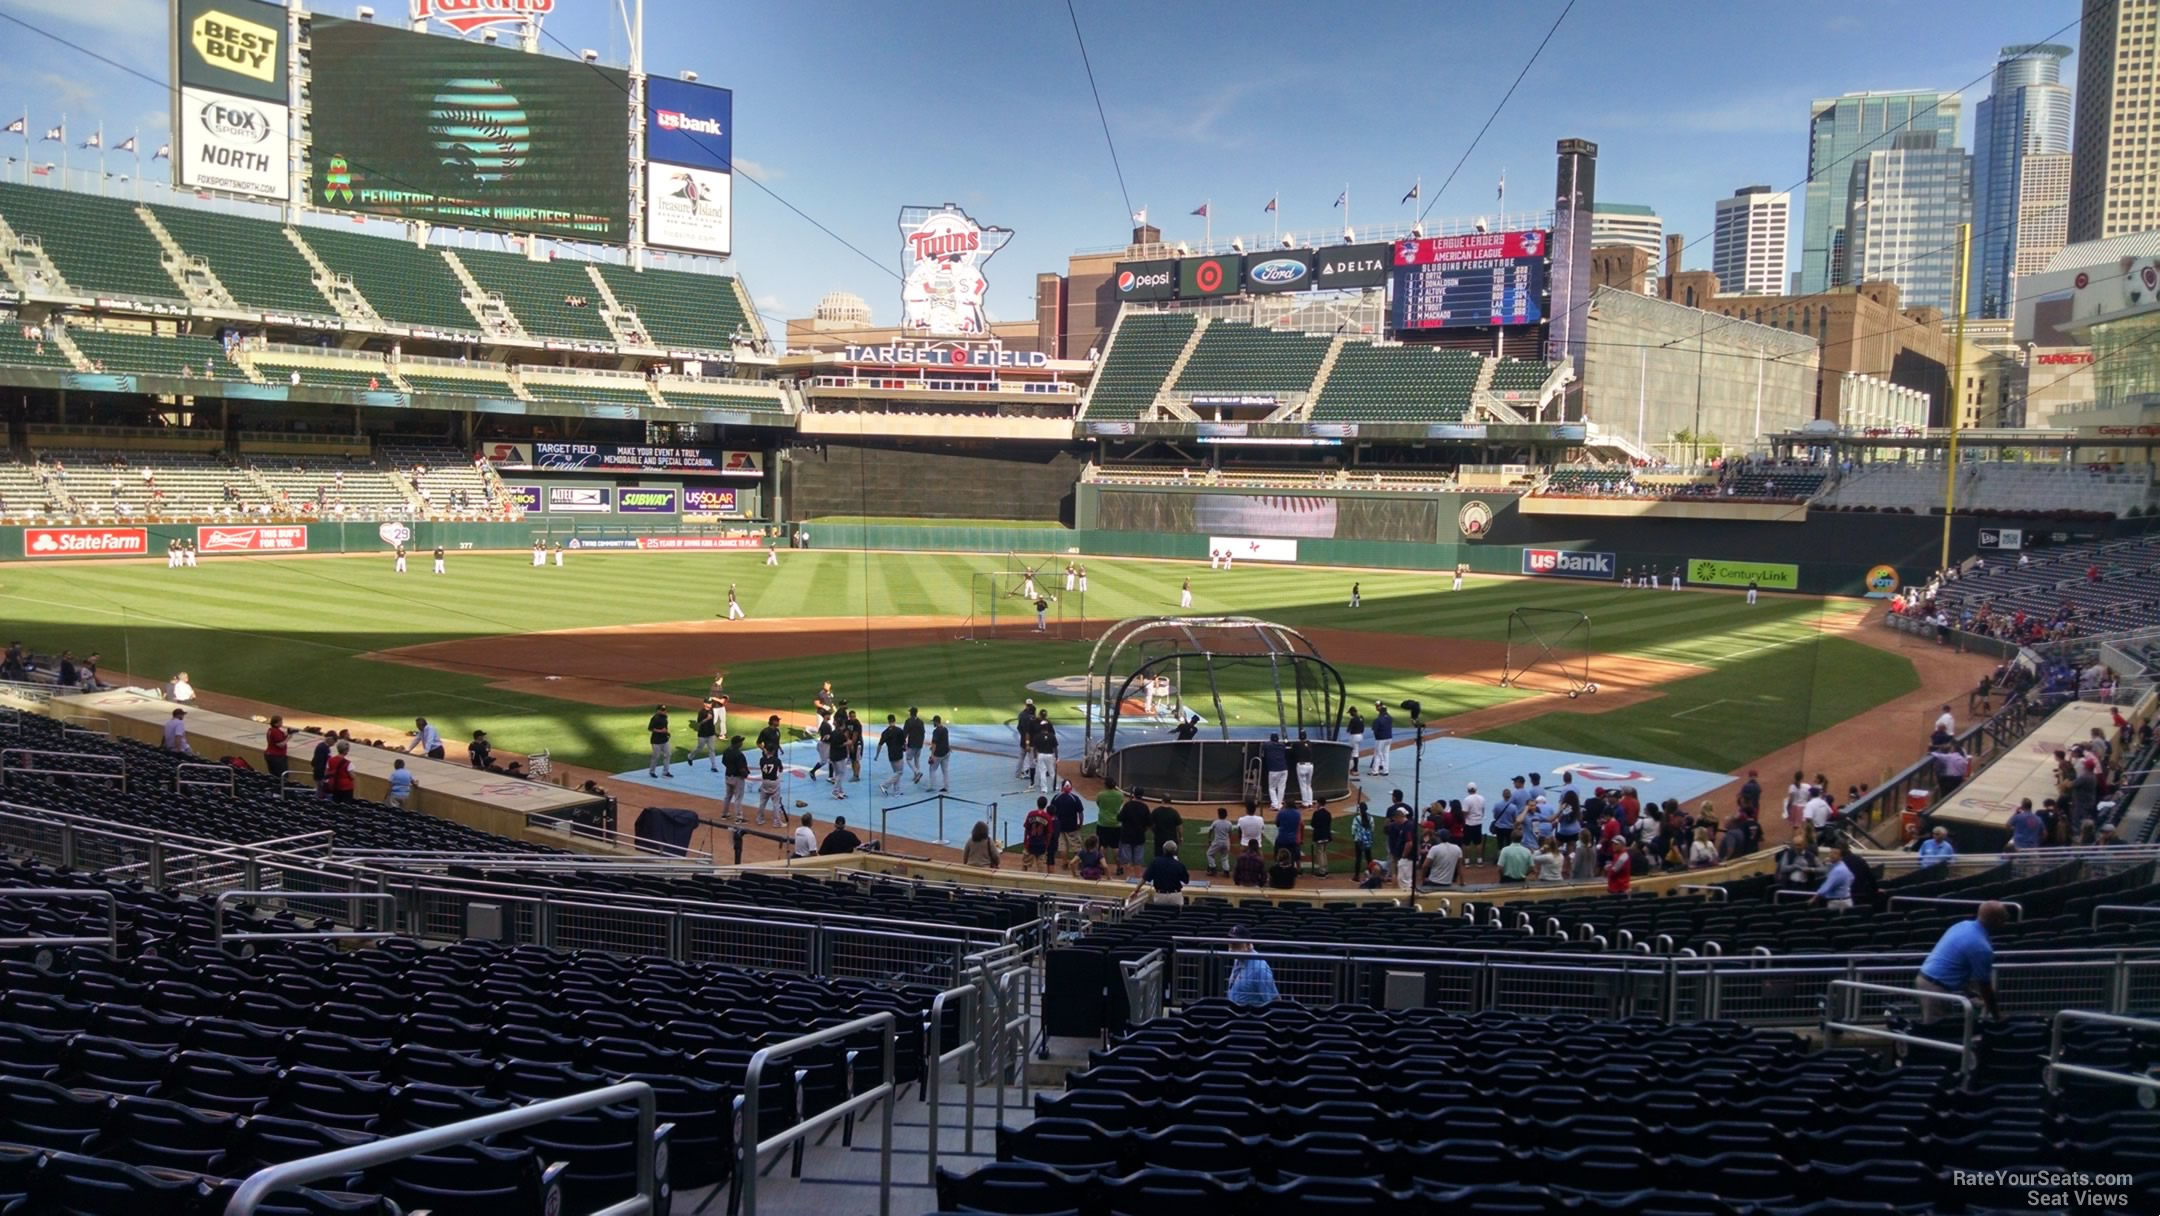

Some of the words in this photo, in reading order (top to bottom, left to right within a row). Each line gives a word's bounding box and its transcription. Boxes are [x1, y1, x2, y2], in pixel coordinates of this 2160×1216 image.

[204, 19, 274, 55] BEST
[206, 38, 268, 70] BUY
[214, 106, 255, 131] FOX
[214, 124, 257, 139] SPORTS
[201, 143, 270, 173] NORTH
[197, 173, 277, 195] FOXSPORTSNORTH.COM
[657, 196, 691, 214] Treasure
[699, 202, 723, 218] Island
[908, 228, 979, 262] Twins
[1432, 238, 1465, 250] LEAGUE
[1466, 234, 1505, 248] LEADERS
[1433, 250, 1472, 262] AMERICAN
[1474, 248, 1504, 260] LEAGUE
[1261, 263, 1296, 280] Ford
[1337, 260, 1383, 273] DELTA
[1422, 262, 1460, 272] SLUGGING
[1462, 258, 1515, 270] PERCENTAGE
[1136, 272, 1170, 288] pepsi
[1426, 272, 1442, 280] ORTIZ
[1426, 278, 1459, 288] DONALDSON
[1425, 287, 1446, 295] ALTUVE
[1424, 296, 1443, 304] BETTS
[1424, 303, 1442, 312] TROUT
[1424, 310, 1451, 319] MACHADO
[845, 346, 948, 364] TARGET
[974, 351, 1048, 367] FIELD
[2036, 354, 2086, 365] TARGET
[536, 443, 571, 454] TARGET
[572, 444, 597, 454] FIELD
[617, 447, 635, 455] MAKE
[637, 448, 653, 456] YOUR
[654, 448, 674, 456] EVENT
[682, 449, 700, 457] TRULY
[604, 456, 643, 465] MEMORABLE
[644, 456, 656, 465] AND
[658, 457, 682, 466] SPECIAL
[683, 457, 714, 467] OCCASION.
[621, 493, 674, 506] SUBWAY
[259, 529, 276, 538] THIS
[394, 528, 409, 539] 29
[260, 539, 275, 548] FOR
[647, 538, 658, 548] 25
[1720, 568, 1788, 582] CenturyLink
[763, 764, 774, 774] 47
